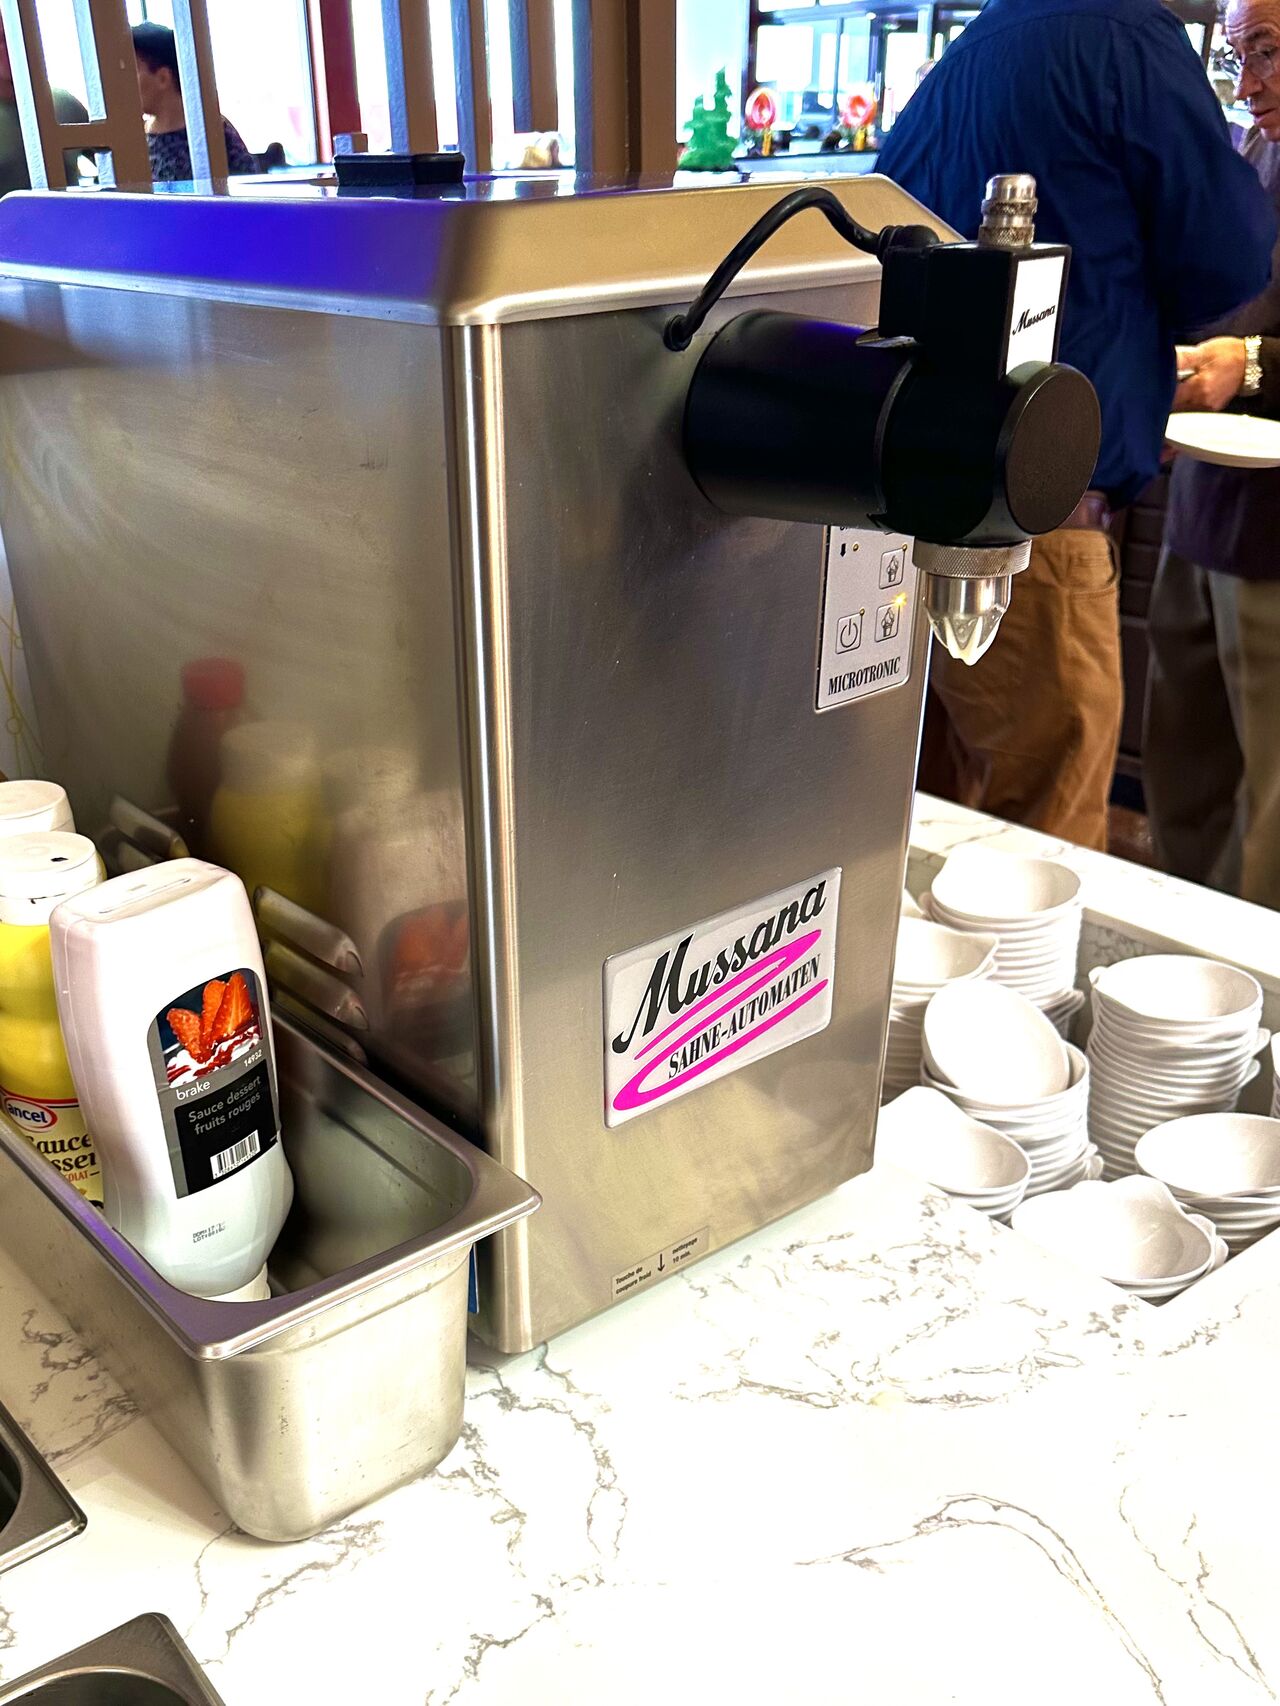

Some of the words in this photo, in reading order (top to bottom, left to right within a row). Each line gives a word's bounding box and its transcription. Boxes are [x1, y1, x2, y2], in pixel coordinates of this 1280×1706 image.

[1012, 305, 1056, 336] Mussana
[828, 656, 901, 696] MICROTRONIC
[612, 880, 828, 1054] Mussana
[669, 953, 821, 1079] SAHNE-AUTOMATEN
[244, 1049, 262, 1067] 14932
[176, 1081, 211, 1101] brake
[188, 1101, 224, 1123] Sauce
[226, 1076, 261, 1105] dessert
[194, 1115, 226, 1135] fruits
[228, 1092, 261, 1119] rouges
[616, 1271, 635, 1285] Touche
[635, 1266, 643, 1275] de
